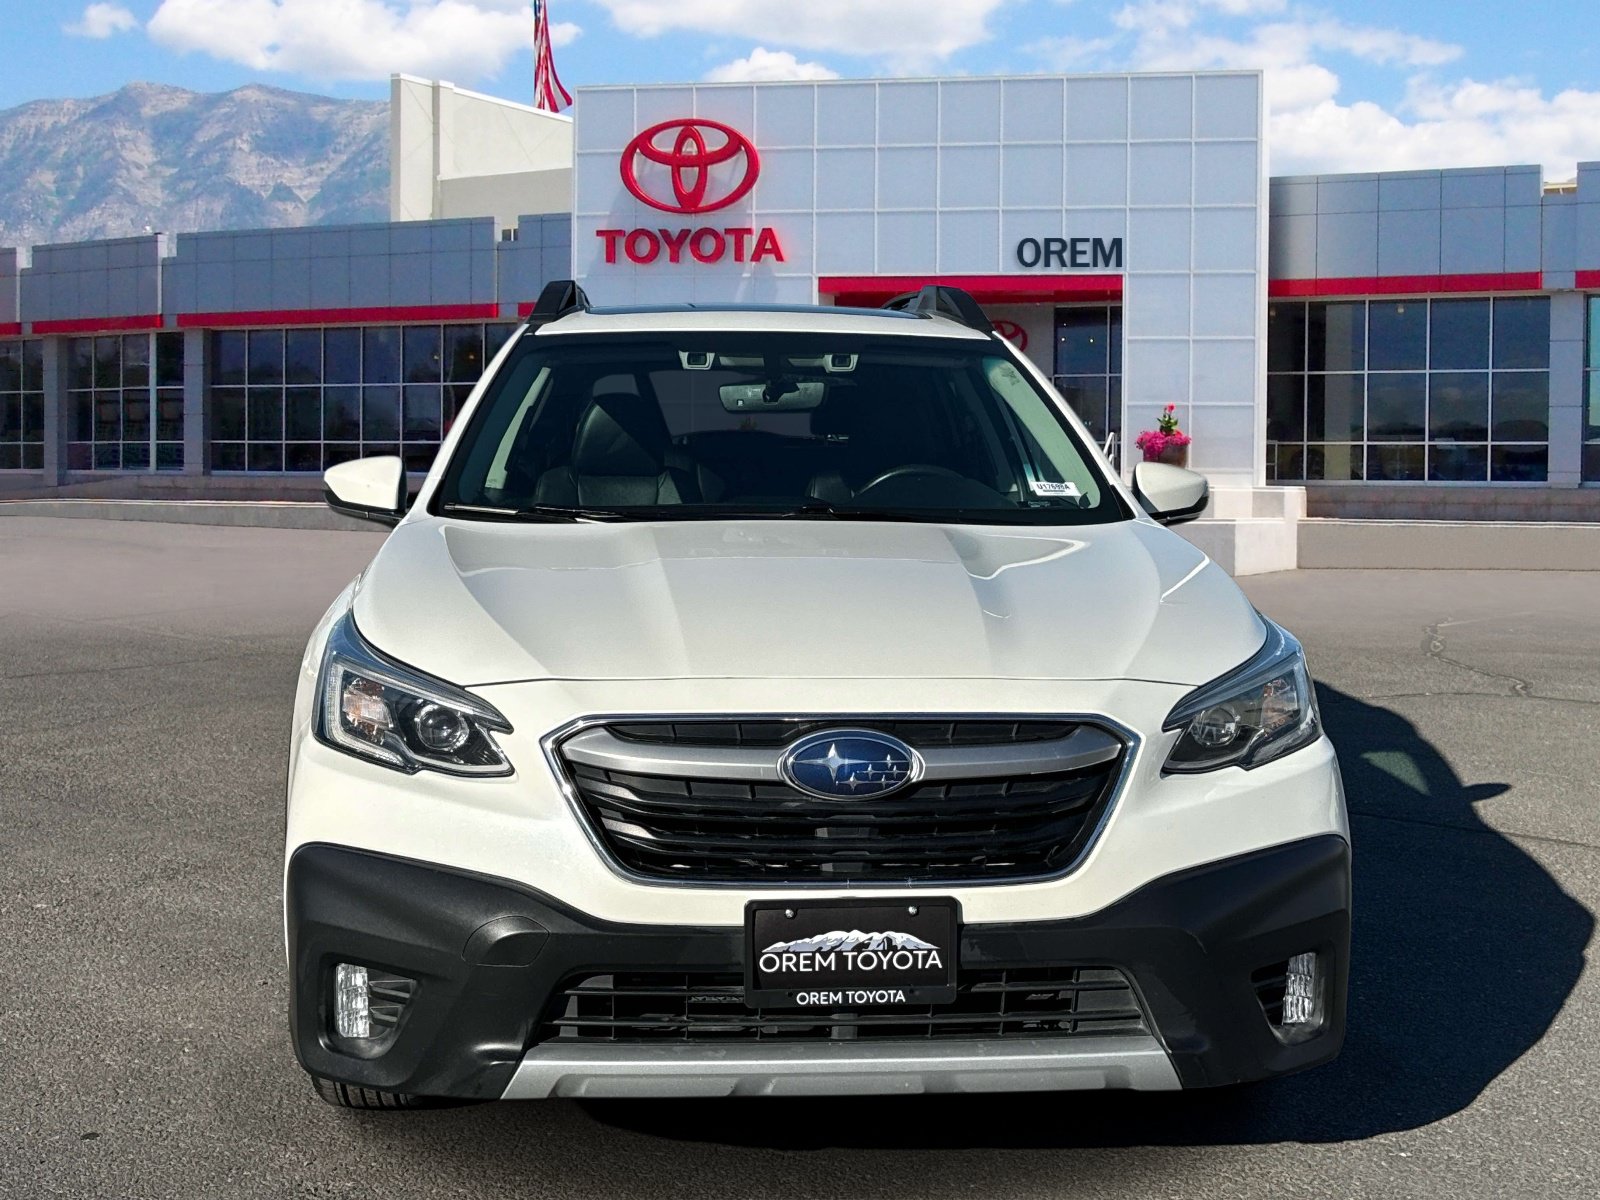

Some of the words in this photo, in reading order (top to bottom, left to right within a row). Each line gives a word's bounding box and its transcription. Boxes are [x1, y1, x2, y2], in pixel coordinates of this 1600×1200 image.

[596, 227, 785, 264] TOYOTA
[1017, 237, 1123, 268] OREM
[759, 952, 836, 973] OREM
[842, 950, 943, 971] TOYOTA
[796, 991, 843, 1006] OREM
[845, 989, 906, 1004] TOYOTA
